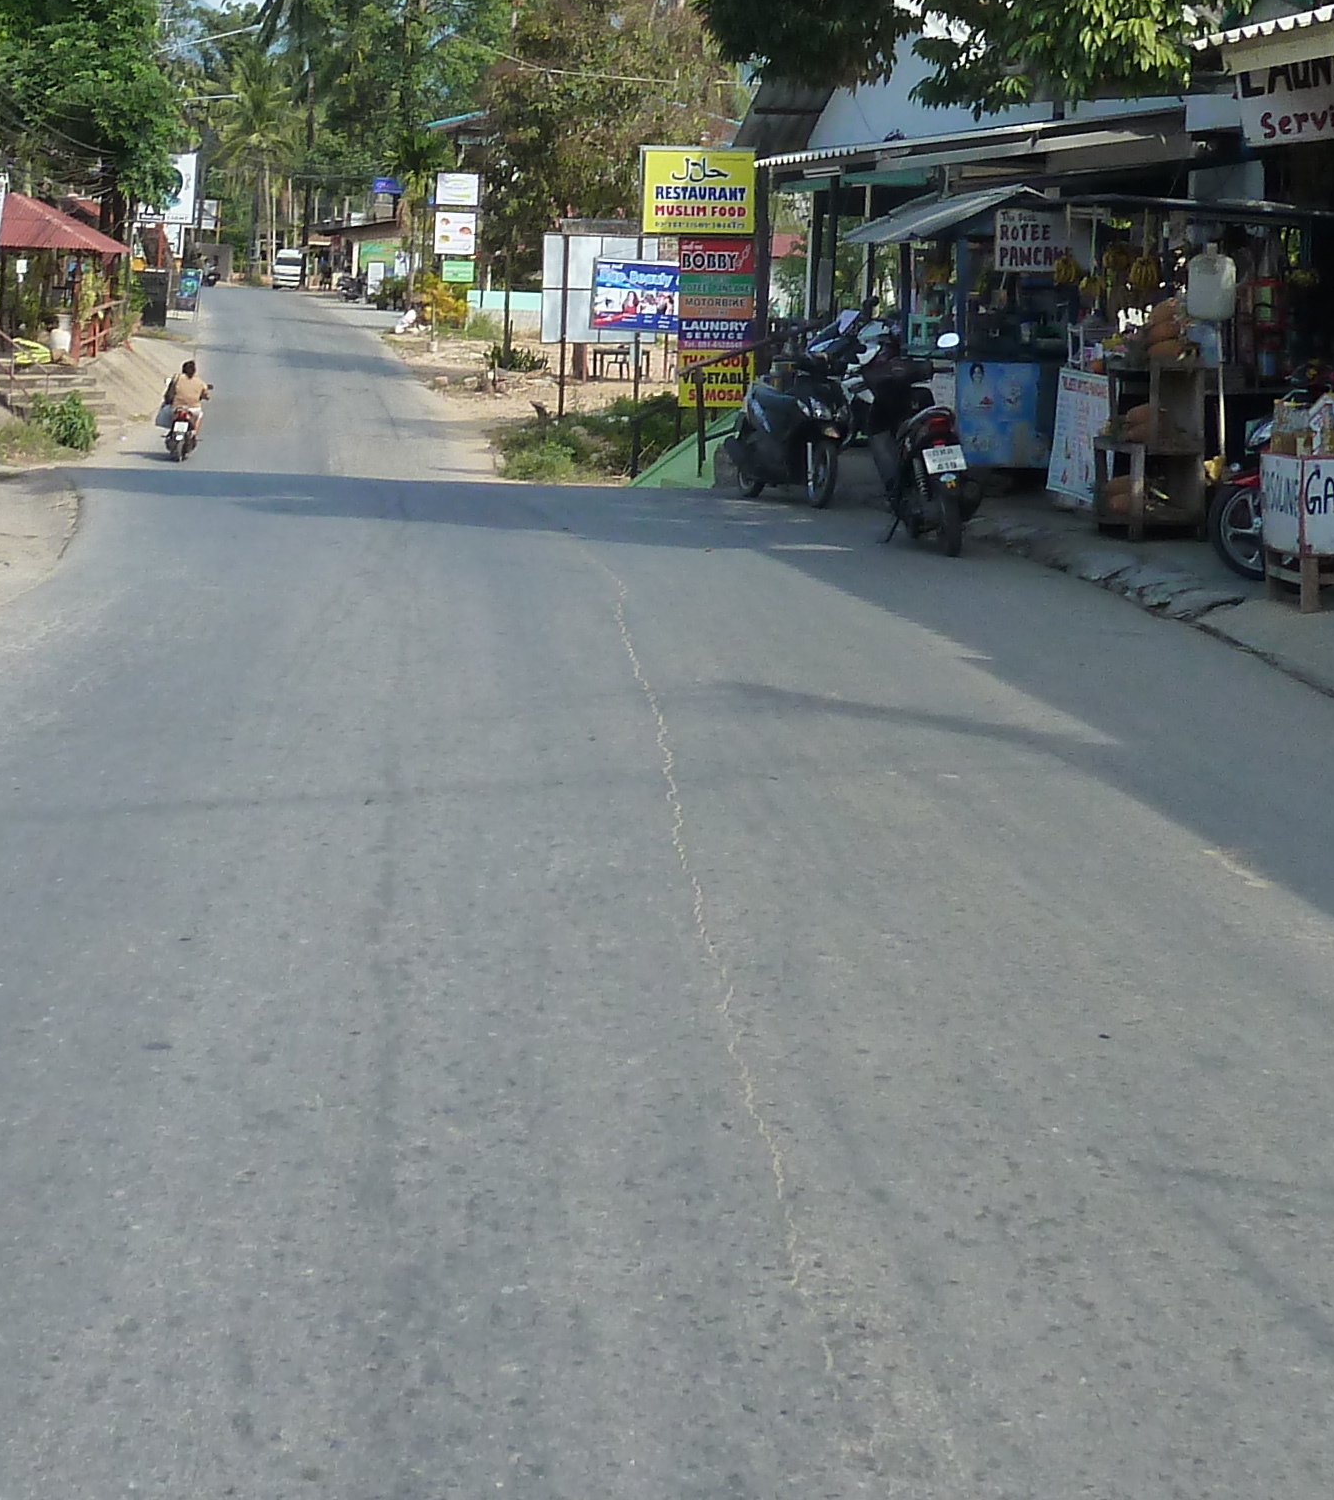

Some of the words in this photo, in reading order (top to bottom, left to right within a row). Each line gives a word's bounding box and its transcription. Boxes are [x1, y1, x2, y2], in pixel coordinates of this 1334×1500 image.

[671, 157, 729, 182] حلال
[655, 186, 746, 201] RESTAURANT
[654, 205, 707, 217] MUSLIM
[711, 206, 746, 217] FOOD
[1000, 224, 1051, 241] ROTEE
[681, 251, 738, 271] BOBBY
[685, 297, 745, 307] MOTORBIKE
[682, 321, 748, 331] LAUNDRY
[689, 389, 744, 401] SMOSA
